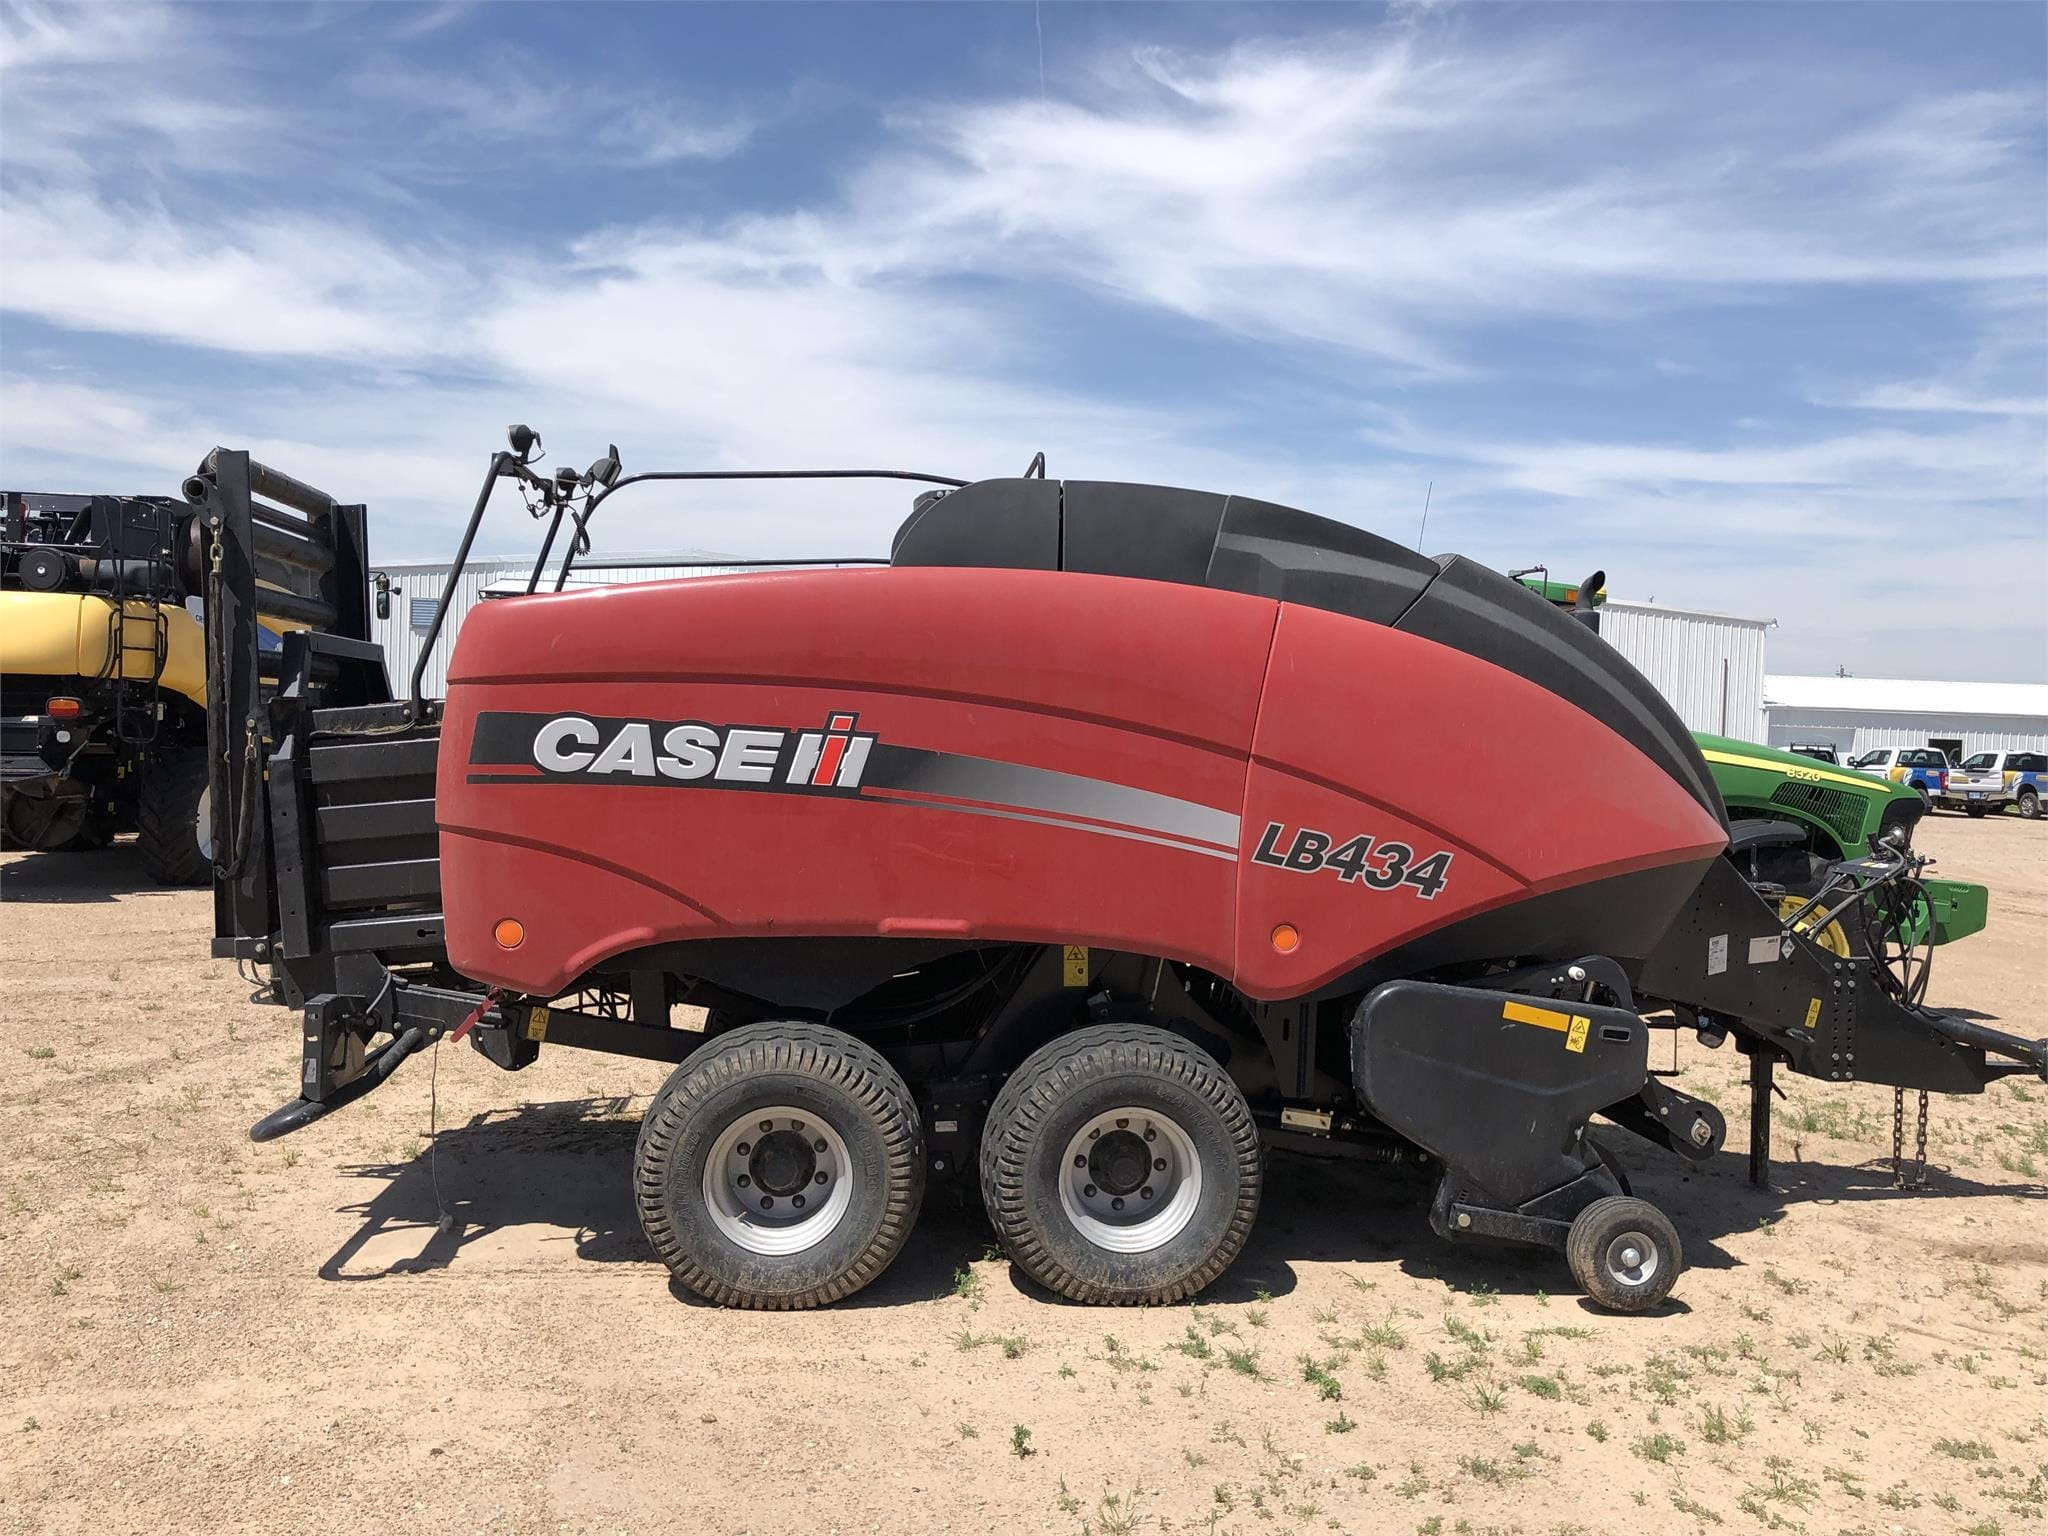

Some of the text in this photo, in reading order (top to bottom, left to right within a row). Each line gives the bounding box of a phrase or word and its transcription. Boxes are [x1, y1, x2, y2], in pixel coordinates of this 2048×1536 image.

[533, 716, 785, 782] CASE
[1786, 767, 1821, 782] 8320
[1251, 820, 1455, 900] LB434
